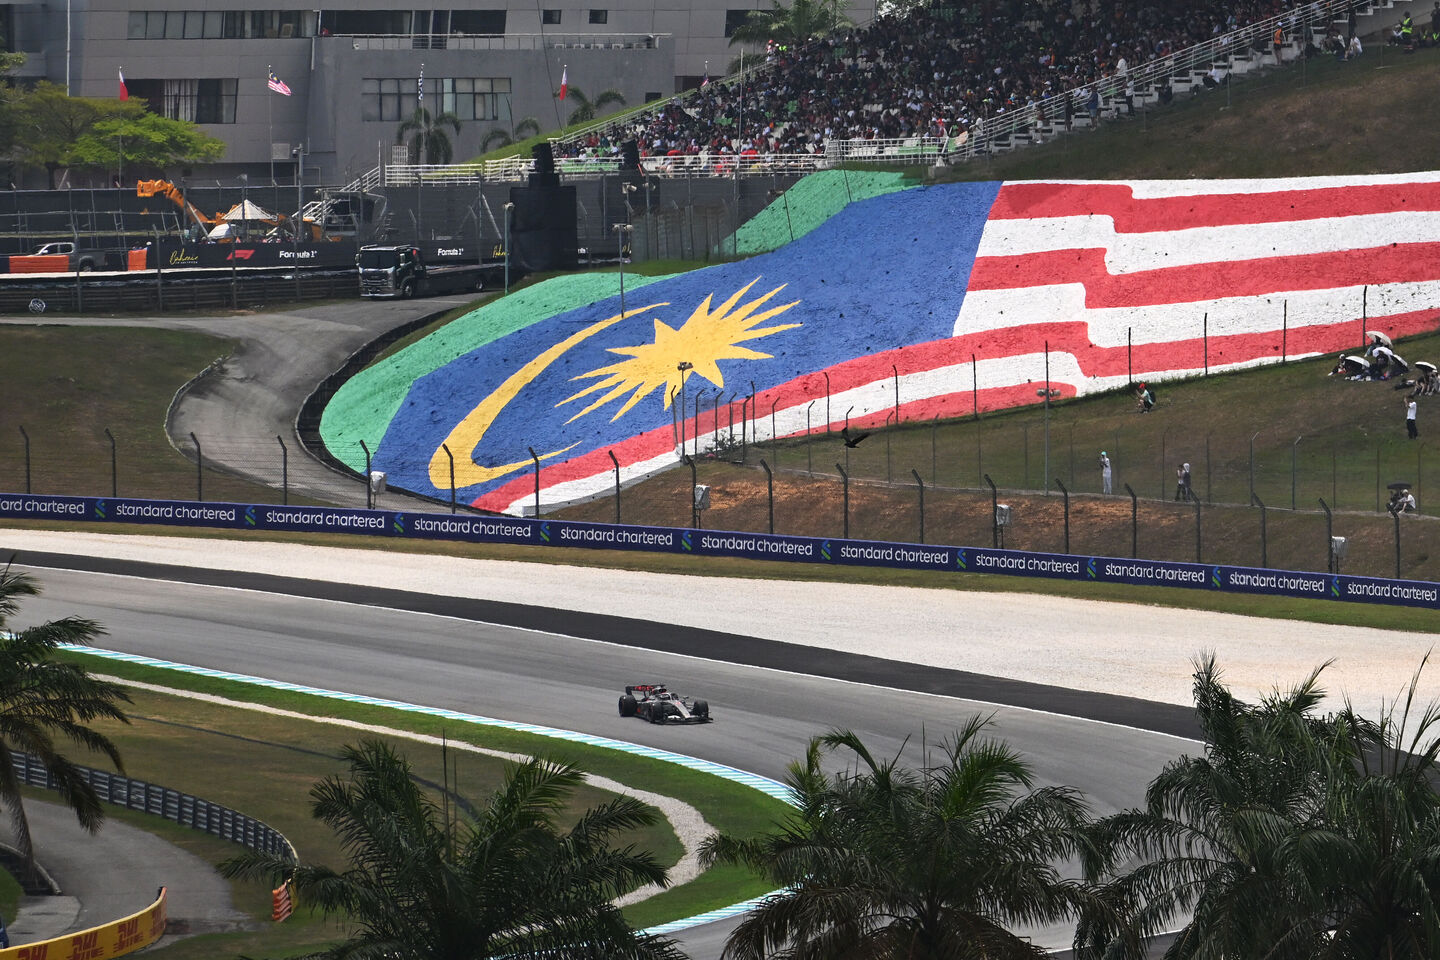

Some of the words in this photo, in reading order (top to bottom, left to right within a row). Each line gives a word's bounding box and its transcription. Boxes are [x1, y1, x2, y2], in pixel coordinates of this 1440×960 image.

[0, 499, 23, 511] ard
[25, 499, 85, 515] chartered
[116, 502, 173, 518] standard
[175, 505, 236, 521] chartered
[266, 509, 323, 525] standard
[325, 513, 385, 529] chartered
[414, 517, 471, 534] standard
[472, 521, 531, 538] chartered
[560, 527, 615, 542] standard
[616, 530, 673, 546] chartered
[701, 535, 755, 551] standard
[756, 540, 813, 556] chartered
[840, 545, 893, 561] standard
[894, 548, 949, 564] chartered
[976, 553, 1026, 569] standard
[1027, 558, 1079, 574] chartered
[1105, 562, 1154, 579] standard
[1155, 567, 1205, 583] chartered
[1229, 571, 1276, 588] standard
[1277, 576, 1325, 593] chartered
[1347, 581, 1390, 597] standard
[1391, 585, 1437, 602] chartered
